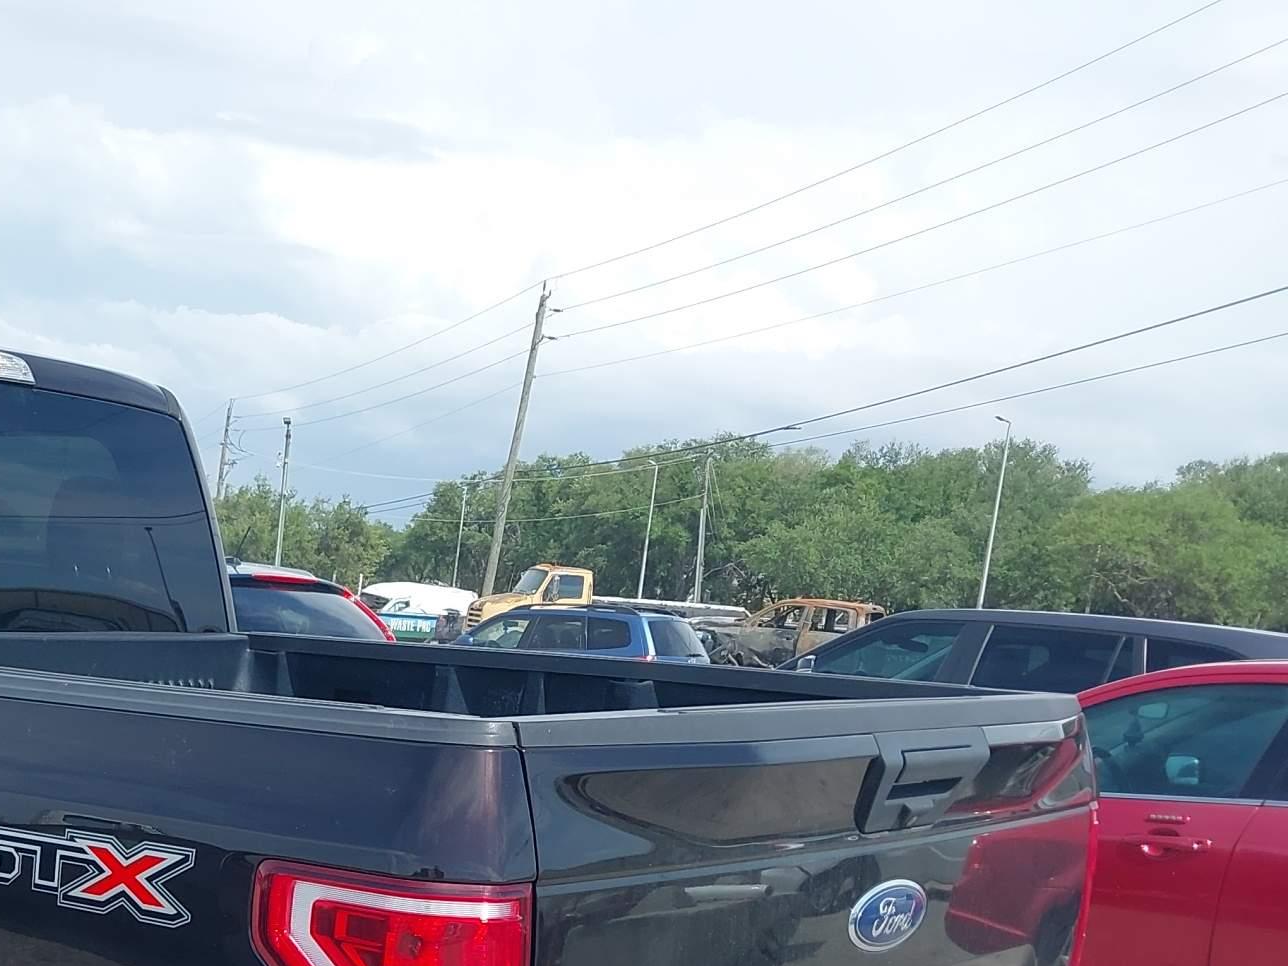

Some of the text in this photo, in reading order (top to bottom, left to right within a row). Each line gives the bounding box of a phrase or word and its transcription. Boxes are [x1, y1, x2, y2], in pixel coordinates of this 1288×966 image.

[391, 618, 431, 632] WASTE PRO
[871, 897, 916, 938] Ford
